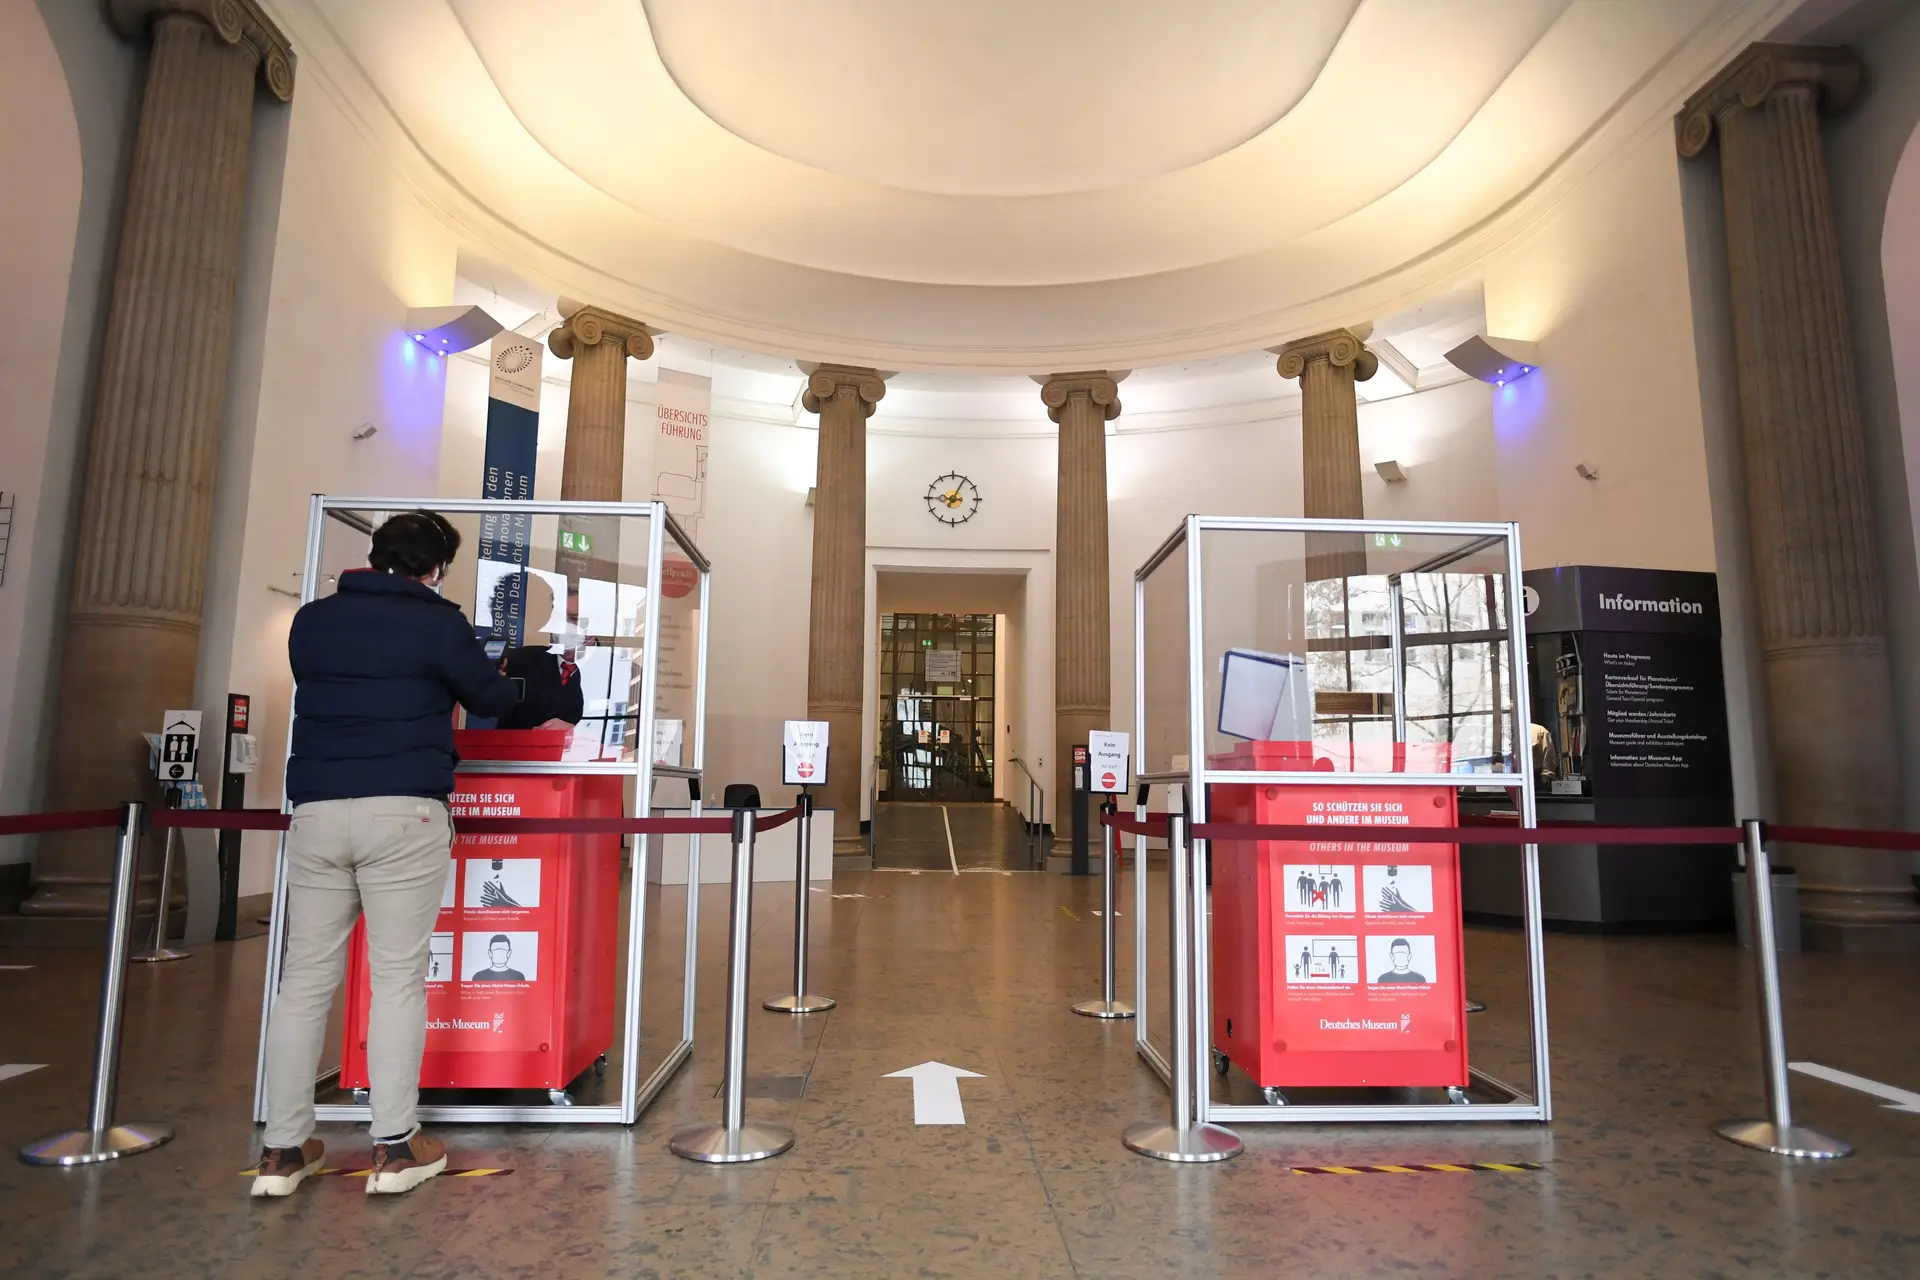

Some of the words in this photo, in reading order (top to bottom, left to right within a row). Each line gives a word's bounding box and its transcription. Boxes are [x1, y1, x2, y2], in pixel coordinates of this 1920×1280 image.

[658, 404, 708, 426] ÜBERSICHTS
[662, 422, 702, 440] FÜHRUNG
[486, 466, 498, 492] den
[497, 471, 514, 556] Innovaonen
[1600, 593, 1702, 614] Information
[508, 603, 519, 619] im
[448, 792, 476, 802] ÜTZEN
[480, 794, 492, 802] SIE
[494, 794, 514, 803] SICH
[452, 807, 466, 816] ERE
[469, 807, 480, 816] IM
[483, 807, 520, 816] MUSEUM
[1313, 802, 1324, 812] SO
[1326, 801, 1368, 812] SCHÜTZEN
[1370, 803, 1383, 812] SIE
[1385, 803, 1402, 812] SICH
[1306, 815, 1324, 824] UND
[1327, 815, 1359, 824] ANDERE
[1362, 816, 1372, 824] IM
[1374, 816, 1409, 824] MUSEUM
[461, 836, 477, 844] THE
[479, 836, 518, 844] MUSEUM
[1310, 842, 1342, 852] OTHERS
[1344, 843, 1353, 852] IN
[1356, 843, 1371, 852] THE
[1373, 843, 1409, 852] MUSEUM
[426, 1018, 450, 1029] tsches
[452, 1019, 489, 1029] Museum
[1320, 1018, 1360, 1029] Deutsches
[1362, 1019, 1397, 1029] Museum
